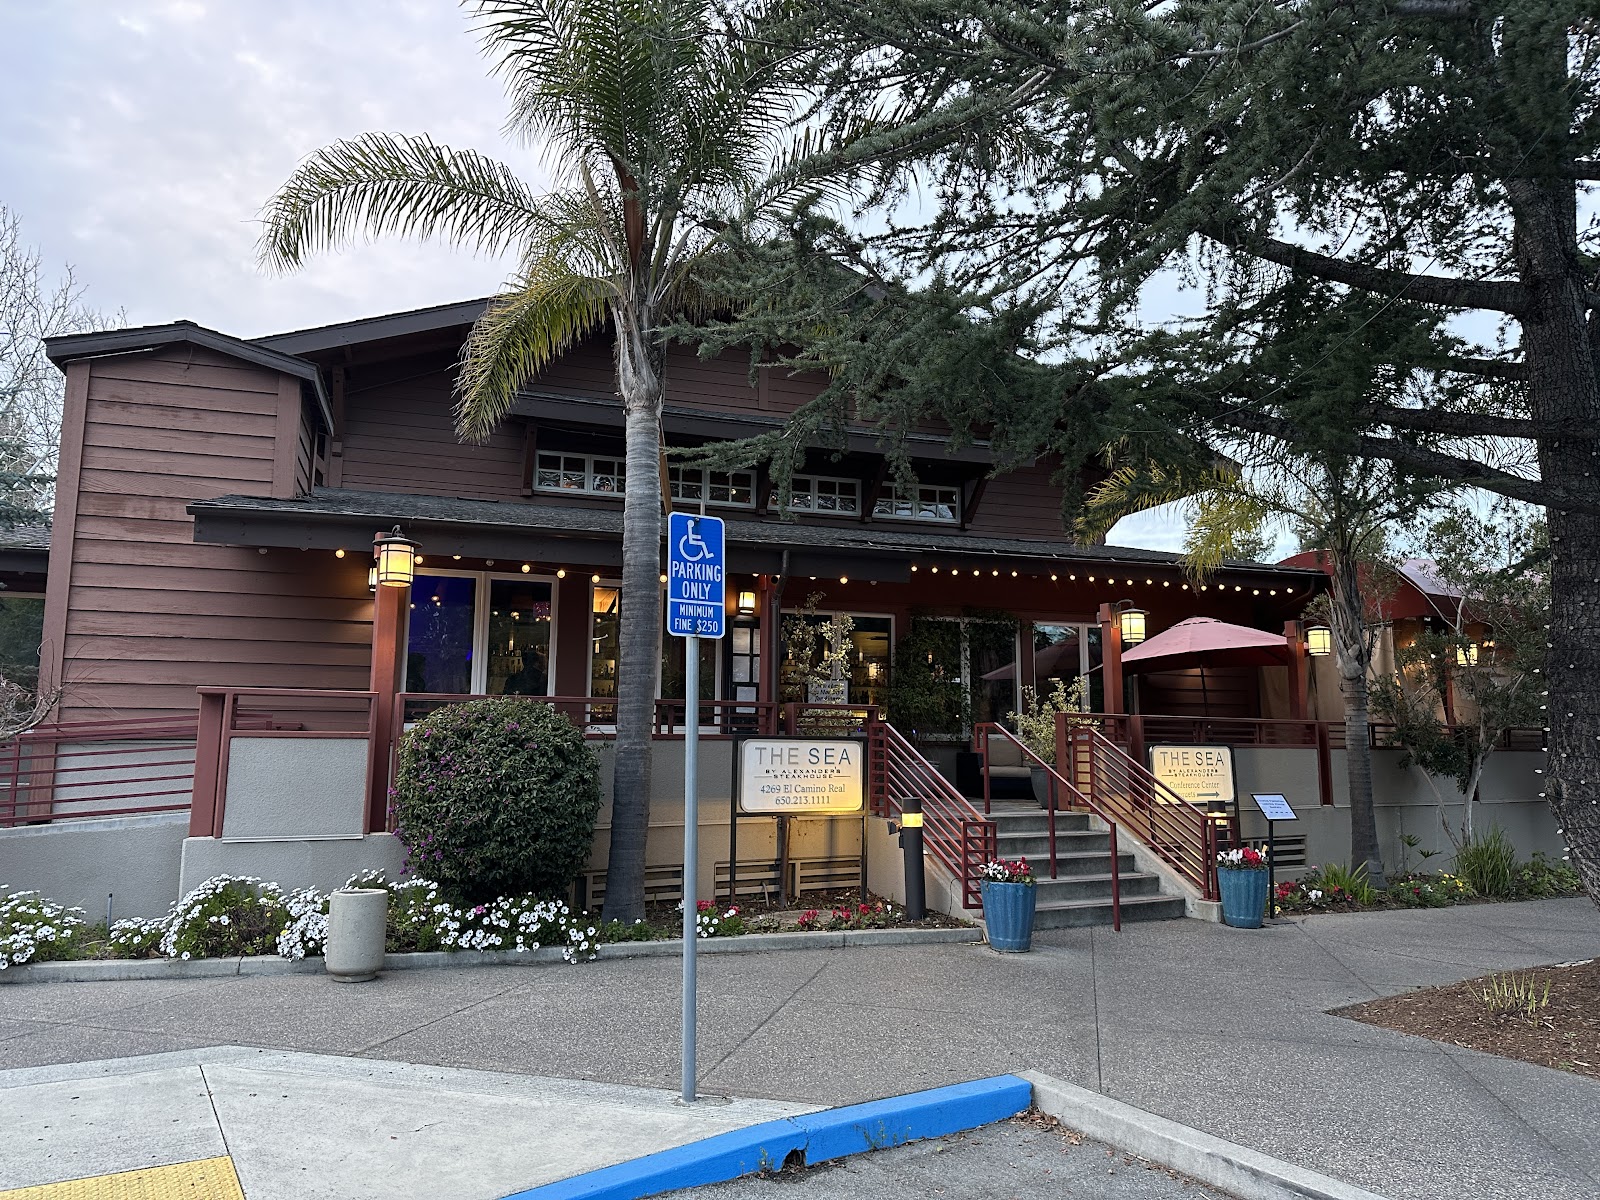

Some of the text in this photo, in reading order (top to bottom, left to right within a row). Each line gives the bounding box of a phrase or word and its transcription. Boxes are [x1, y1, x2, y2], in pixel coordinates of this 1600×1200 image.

[672, 561, 721, 582] PARKING
[682, 581, 711, 600] ONLY
[679, 604, 714, 618] MINIMUM
[674, 618, 718, 633] FINE $250
[755, 747, 851, 765] THE SEA
[1160, 752, 1224, 766] THE SEA
[760, 783, 846, 794] 4269 El Camino Real
[1169, 781, 1219, 789] Conference Center
[775, 795, 830, 805] 650.213.1111
